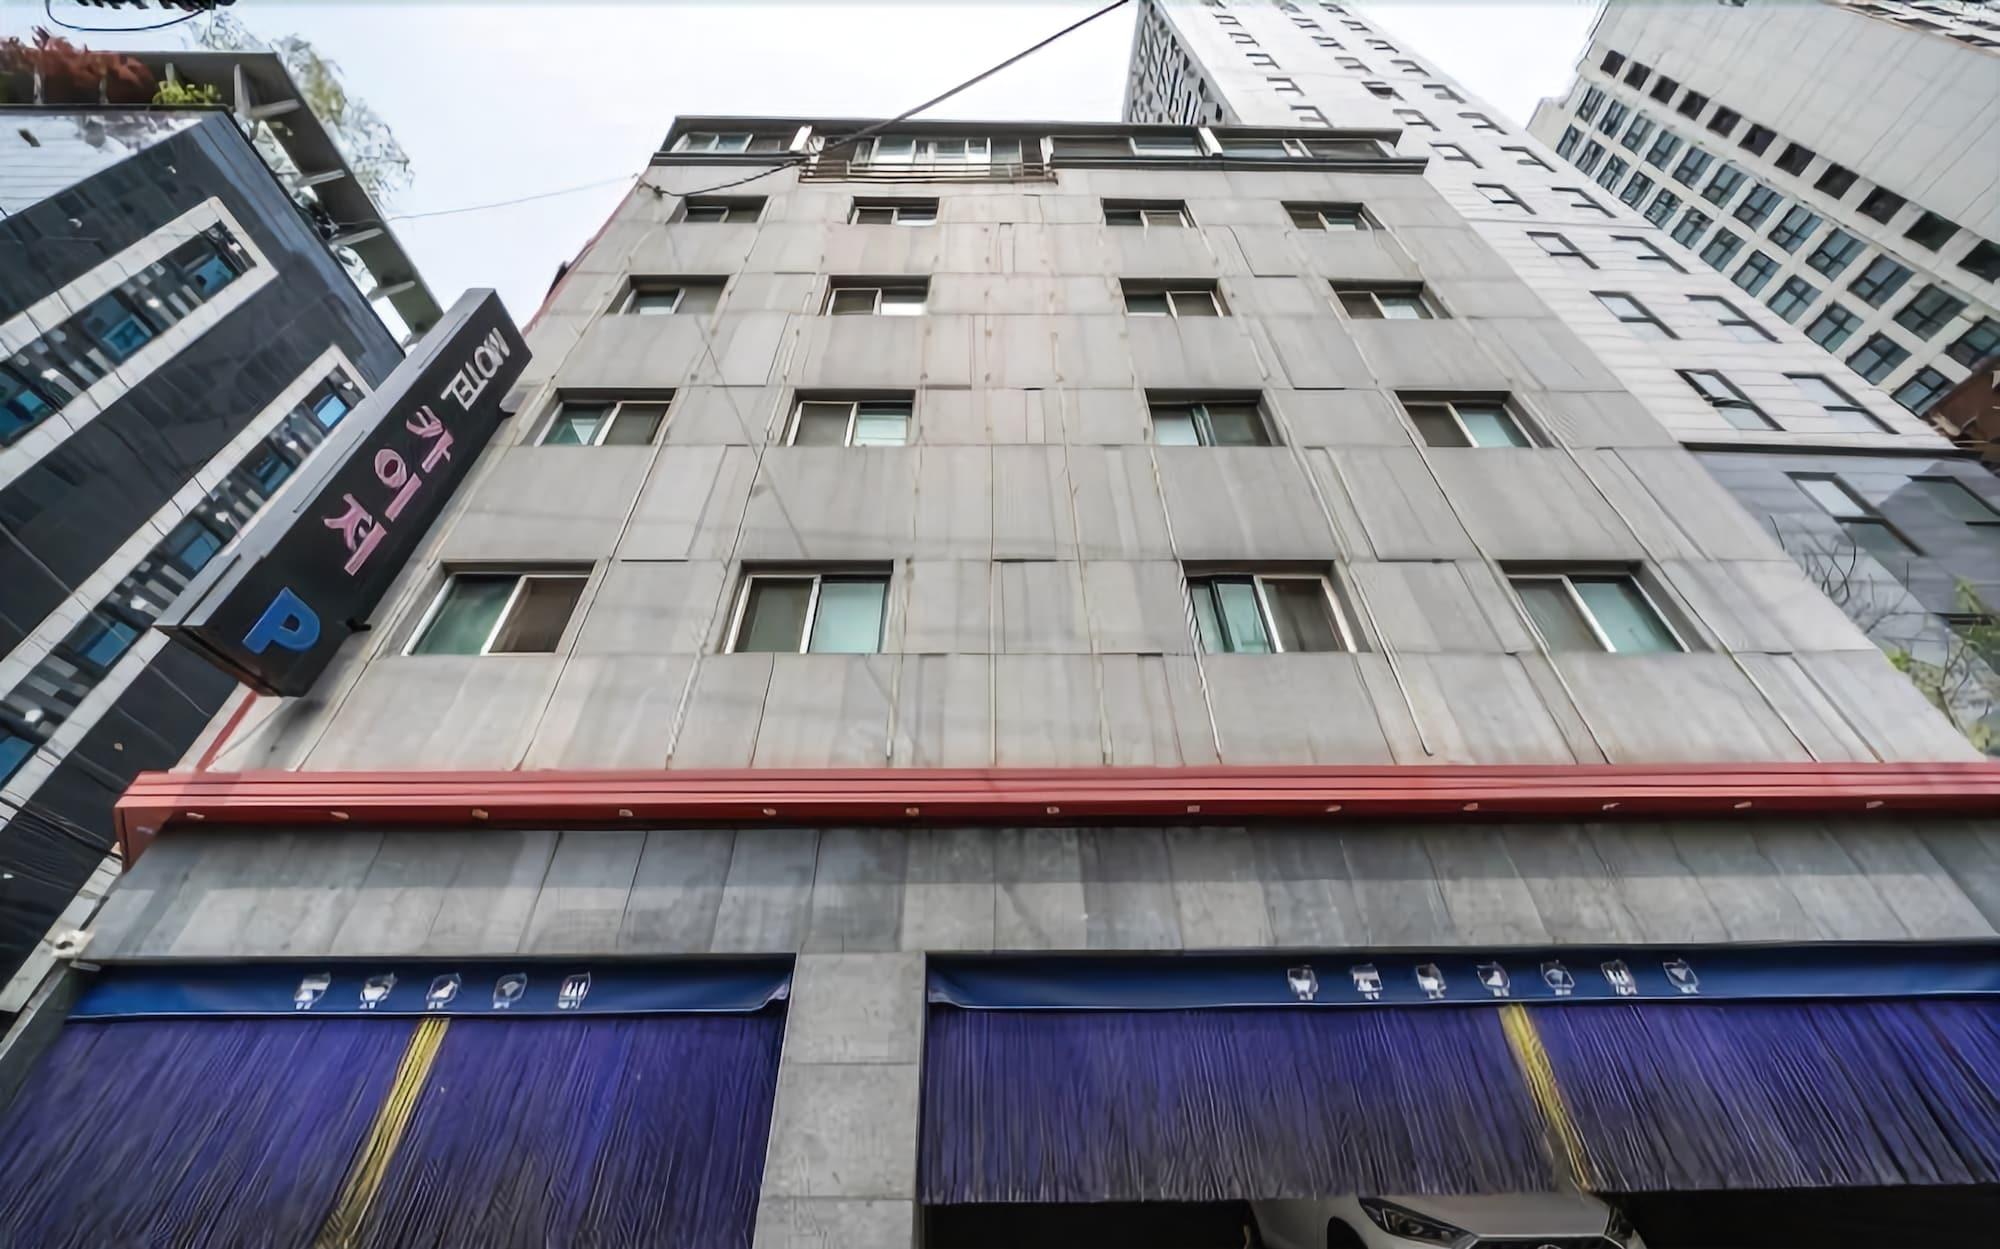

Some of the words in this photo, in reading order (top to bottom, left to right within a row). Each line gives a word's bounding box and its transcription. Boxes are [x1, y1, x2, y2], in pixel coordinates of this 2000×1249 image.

[440, 327, 511, 411] MOTEL
[322, 404, 454, 576] 카이저
[241, 586, 321, 655] P
